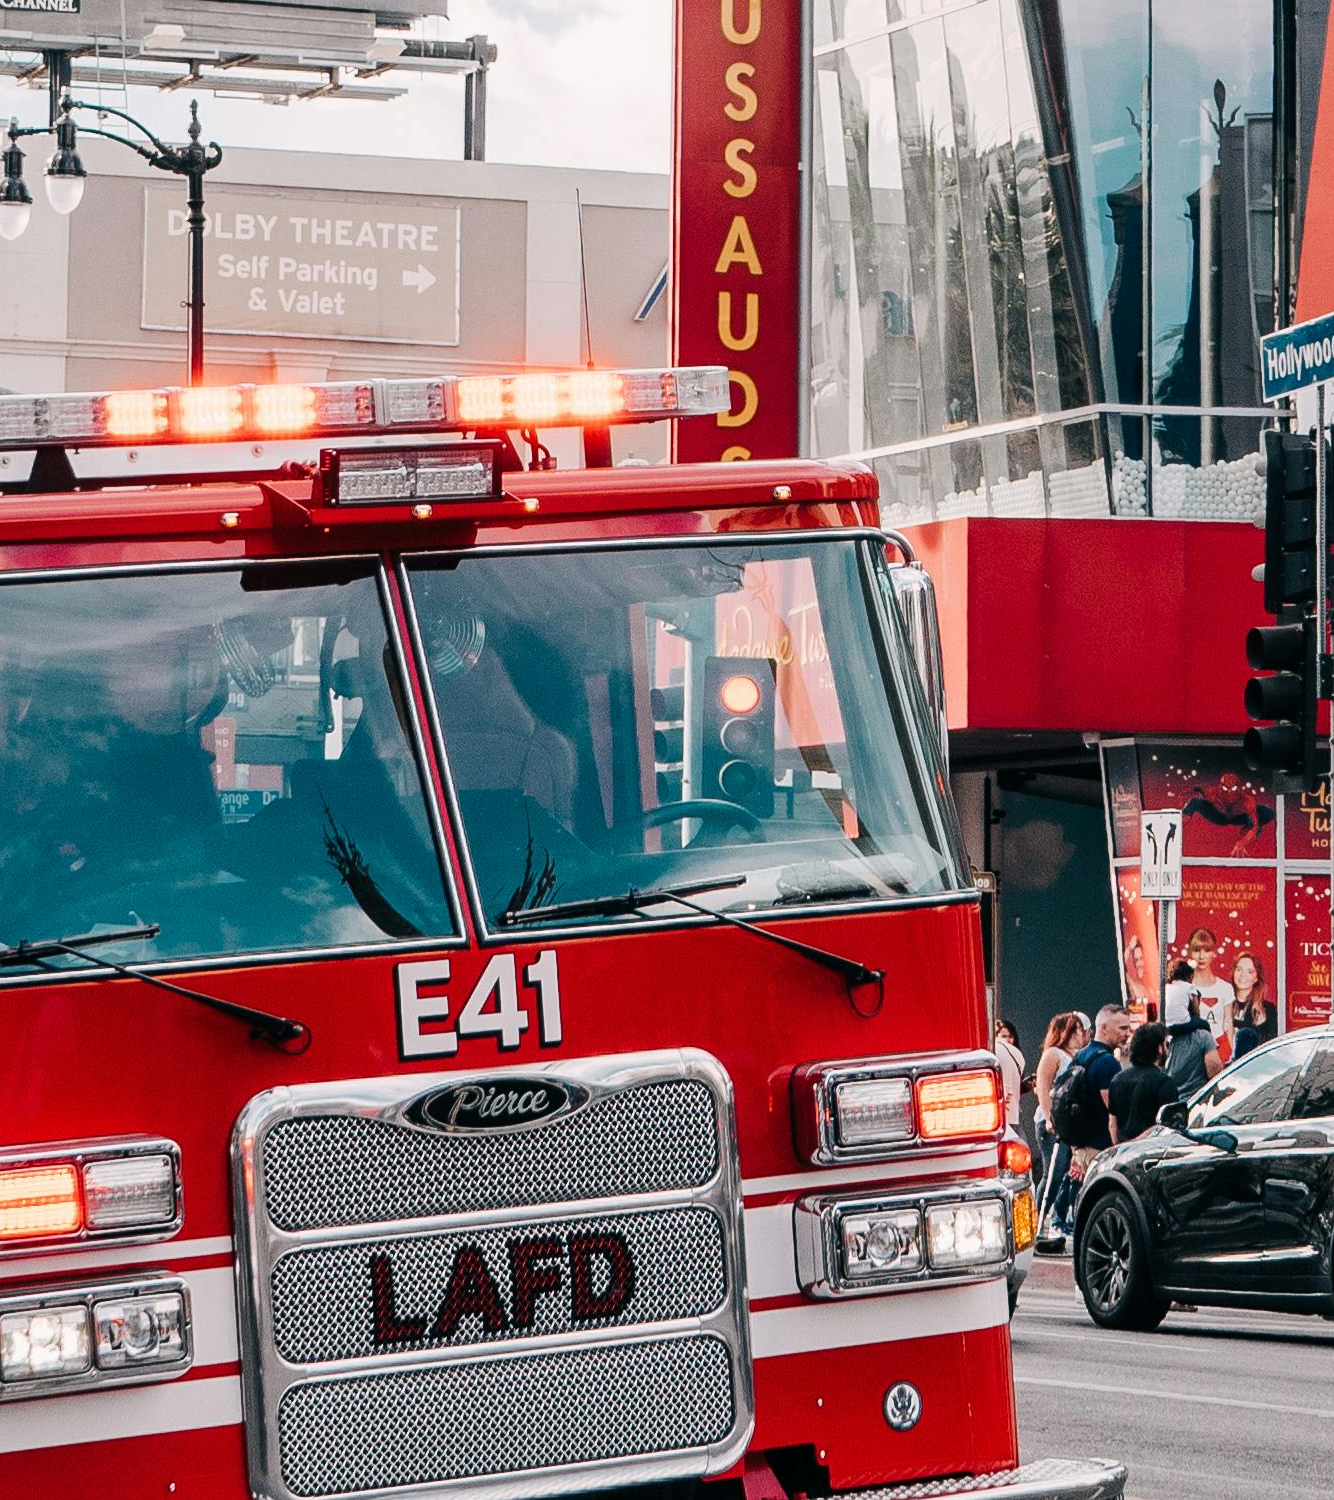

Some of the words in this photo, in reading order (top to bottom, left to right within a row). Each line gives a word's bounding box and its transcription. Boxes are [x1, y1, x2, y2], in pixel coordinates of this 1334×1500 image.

[289, 217, 438, 251] THEATRE
[217, 254, 269, 279] Self
[278, 258, 378, 291] Parking
[248, 288, 267, 311] &
[280, 288, 345, 315] Valet
[394, 949, 563, 1061] E41
[449, 1084, 551, 1127] Pierce
[369, 1233, 636, 1345] LAFD
